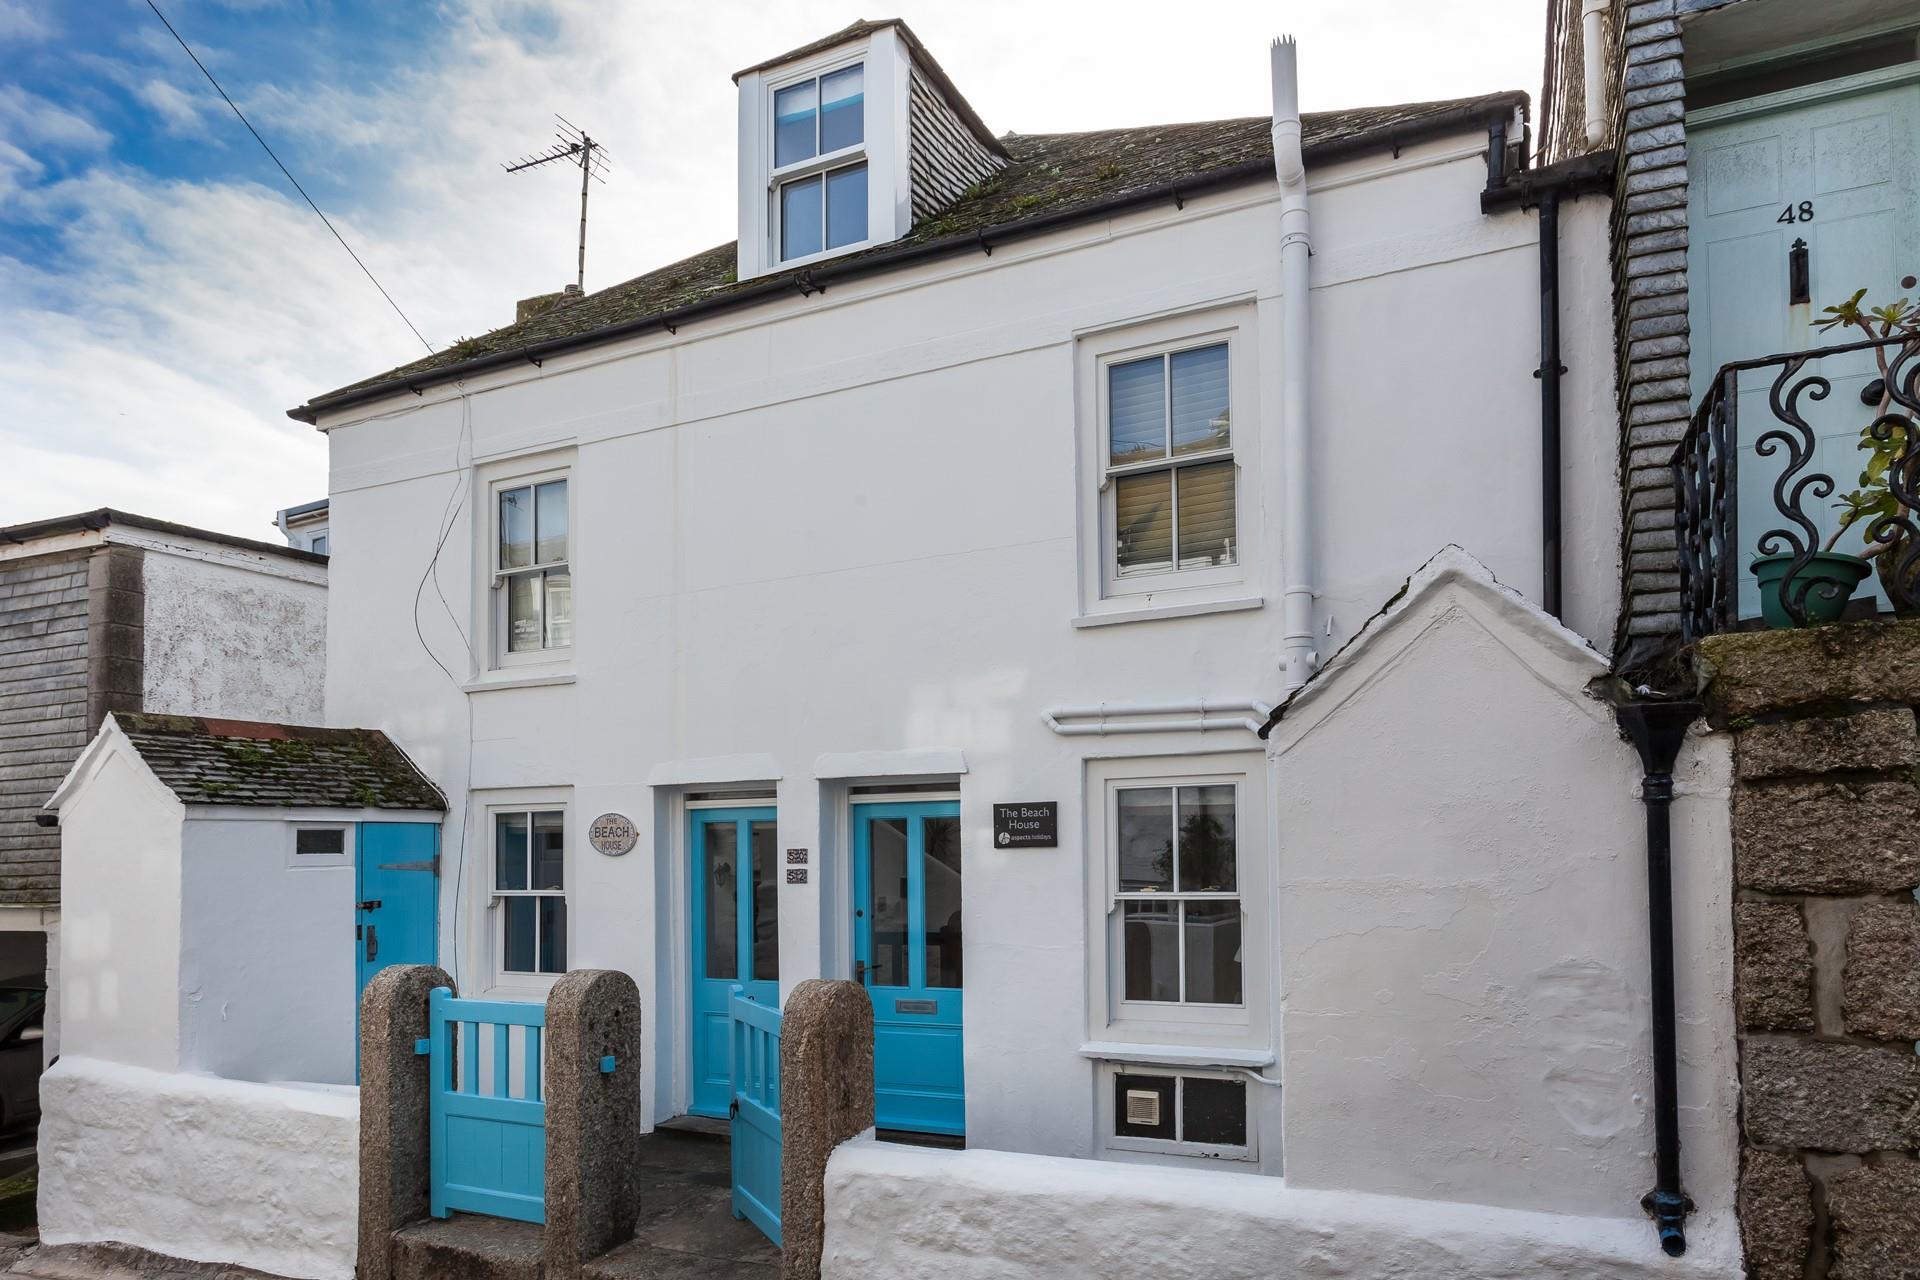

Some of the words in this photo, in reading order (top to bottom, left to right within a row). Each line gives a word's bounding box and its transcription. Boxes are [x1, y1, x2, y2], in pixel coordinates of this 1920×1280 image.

[1777, 200, 1814, 224] 48
[1000, 808, 1018, 818] The
[1021, 807, 1050, 817] Beach
[1009, 820, 1040, 829] House
[594, 826, 630, 838] BEACH
[601, 841, 622, 850] HOUSE
